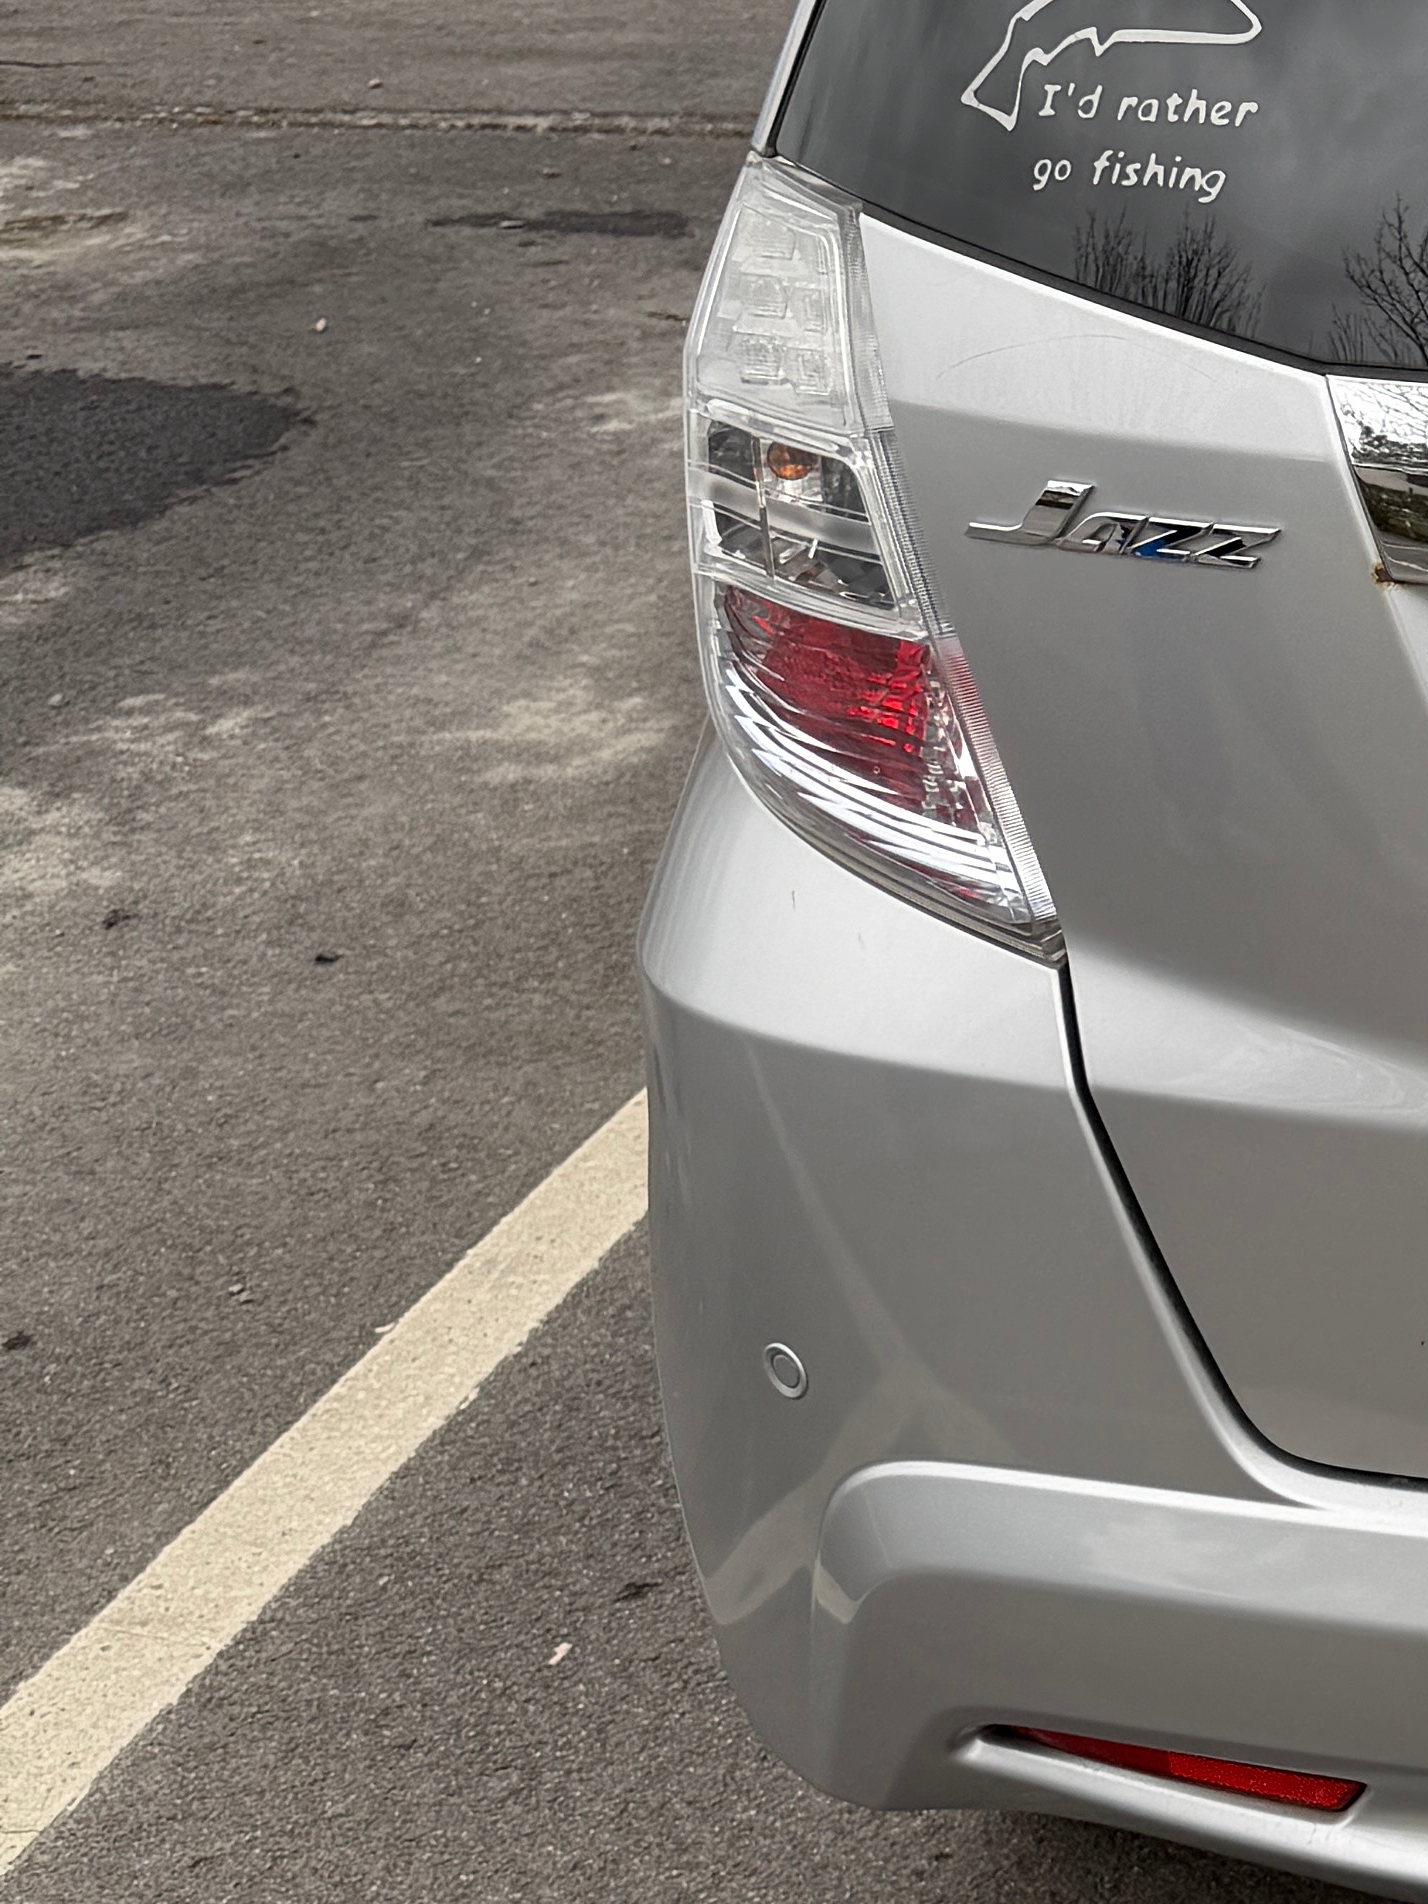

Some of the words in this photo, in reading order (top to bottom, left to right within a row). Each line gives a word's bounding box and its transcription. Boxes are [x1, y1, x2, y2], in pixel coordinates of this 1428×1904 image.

[1038, 82, 1103, 119] I'd
[1116, 88, 1259, 128] rather
[1032, 158, 1072, 191] go
[1092, 149, 1227, 204] fishing
